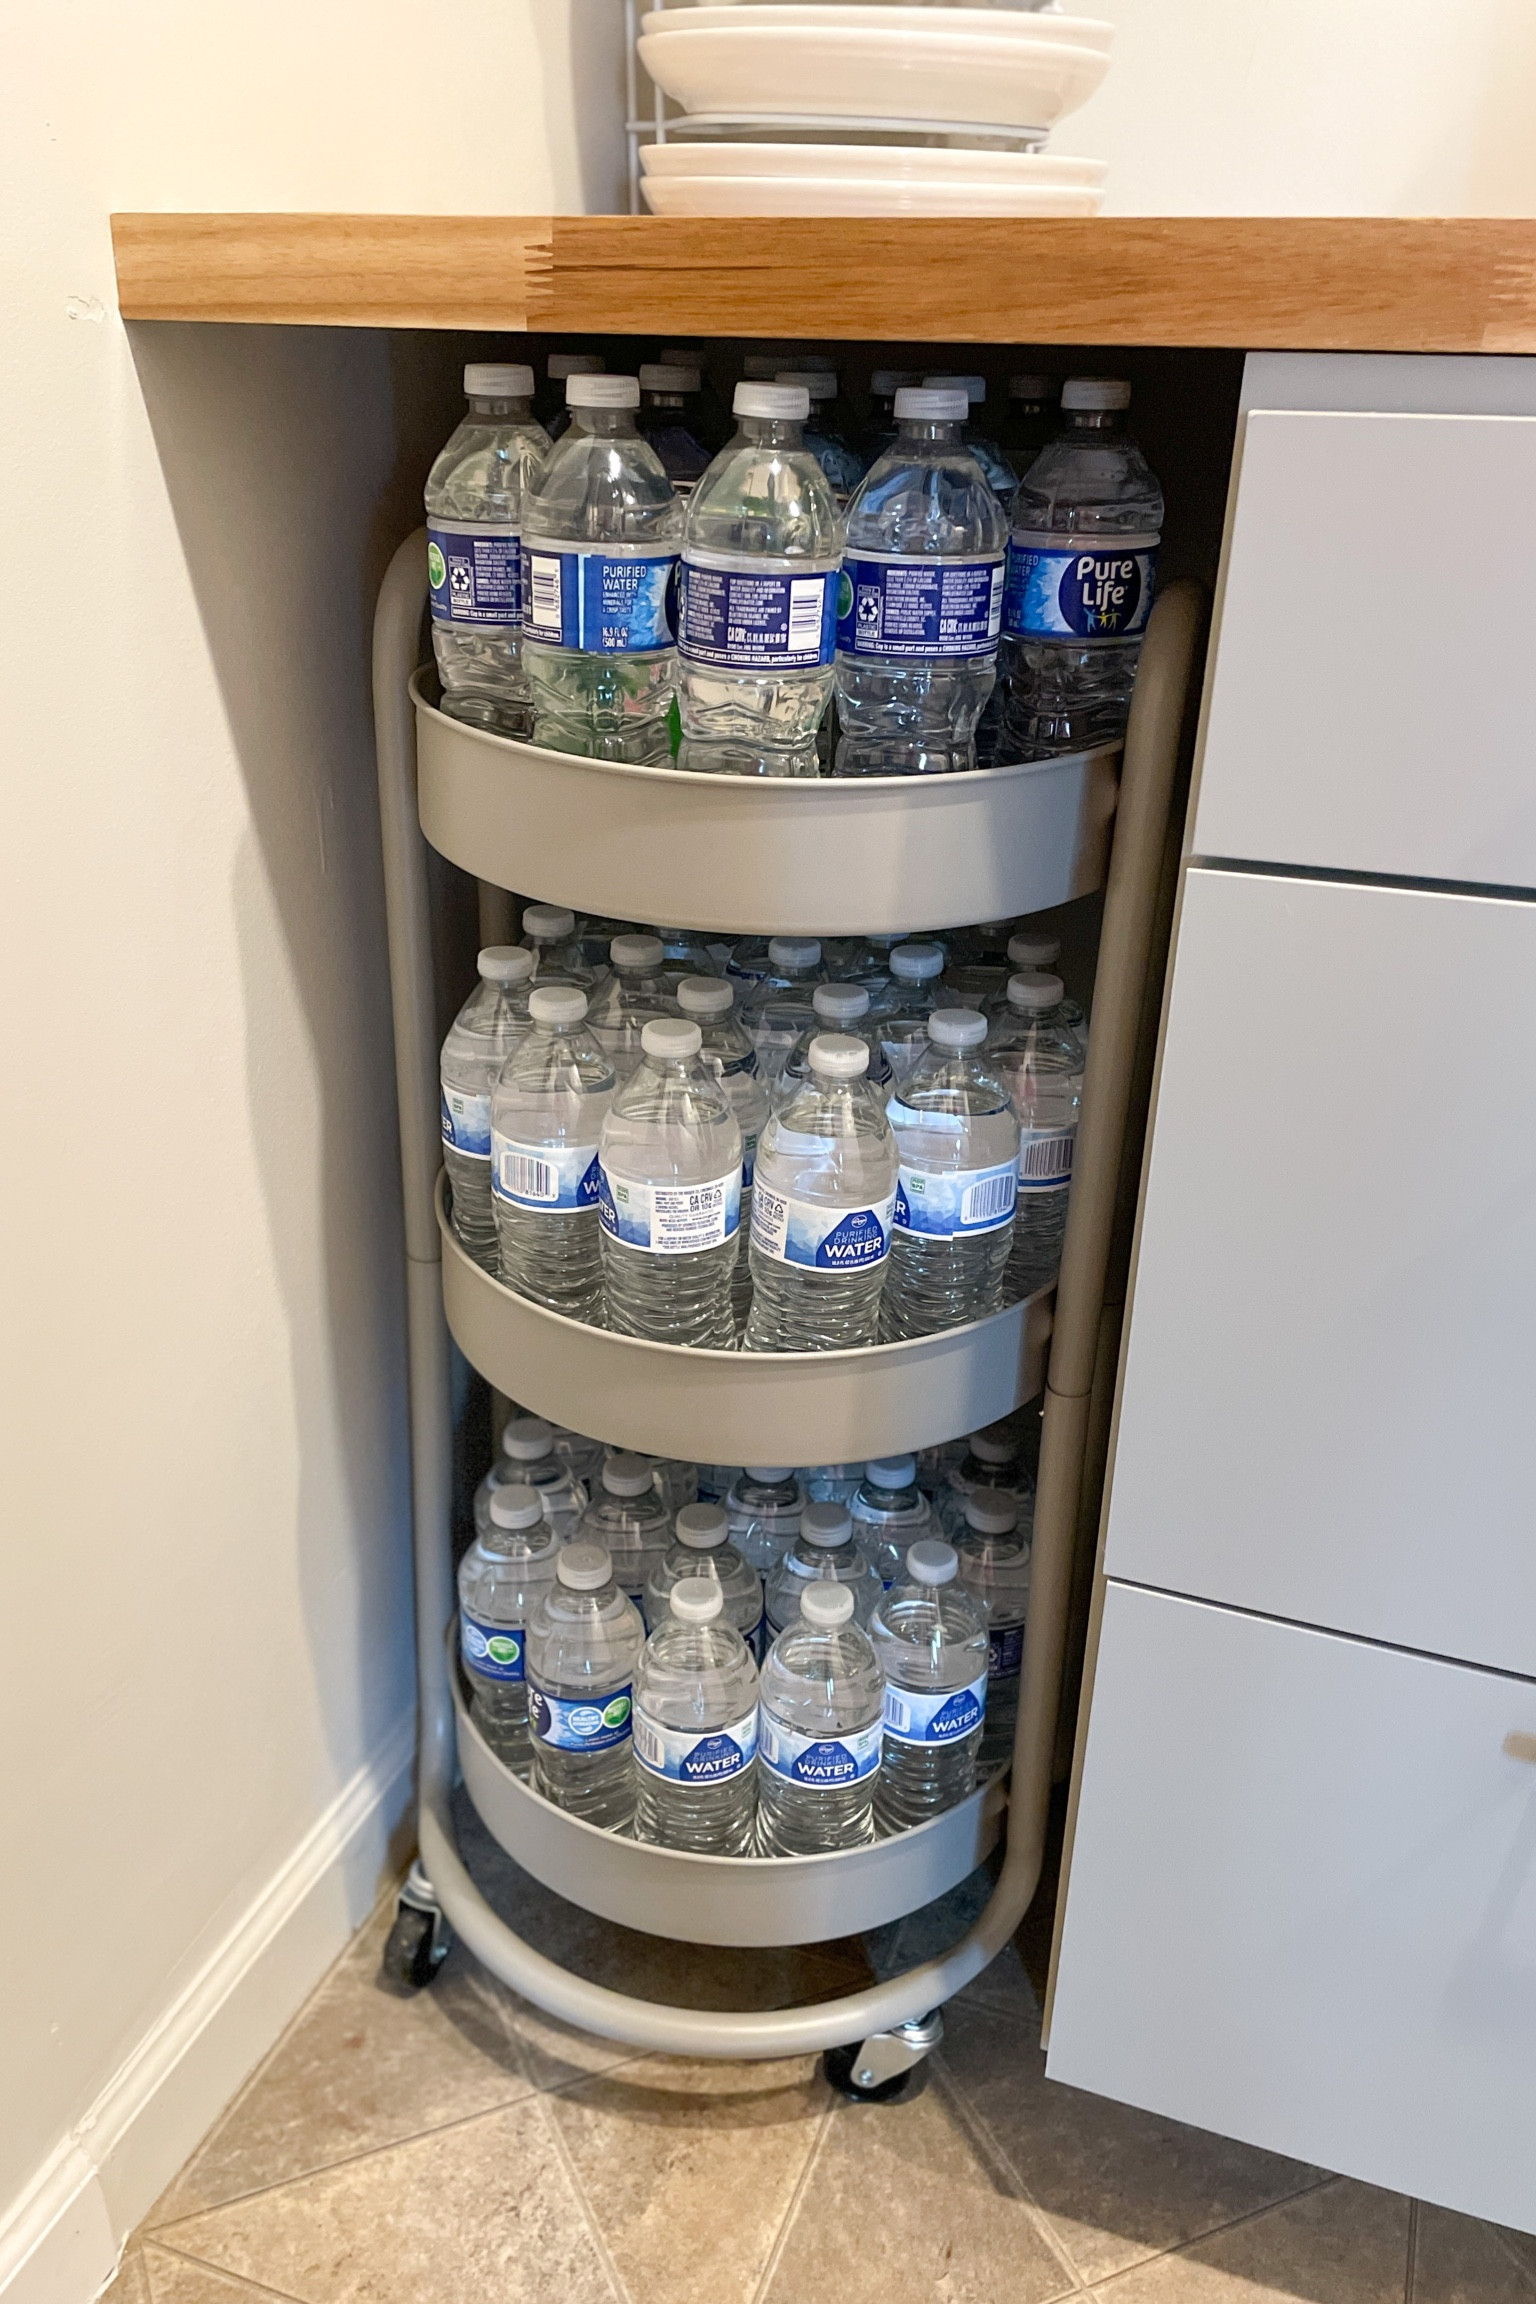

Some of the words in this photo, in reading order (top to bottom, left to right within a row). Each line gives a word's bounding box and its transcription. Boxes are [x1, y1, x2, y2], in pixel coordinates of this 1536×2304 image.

[602, 565, 647, 578] PURIFIED
[1077, 556, 1133, 580] Pure
[602, 578, 638, 591] WATER
[1082, 581, 1125, 611] Life
[690, 1195, 699, 1206] CA
[700, 1192, 713, 1204] CRV
[833, 1233, 878, 1245] DRINKING
[835, 1225, 878, 1239] PURIFIED
[825, 1236, 882, 1258] WATER
[932, 1706, 978, 1733] WATER
[685, 1752, 740, 1773] WATER
[797, 1762, 854, 1777] WATER
